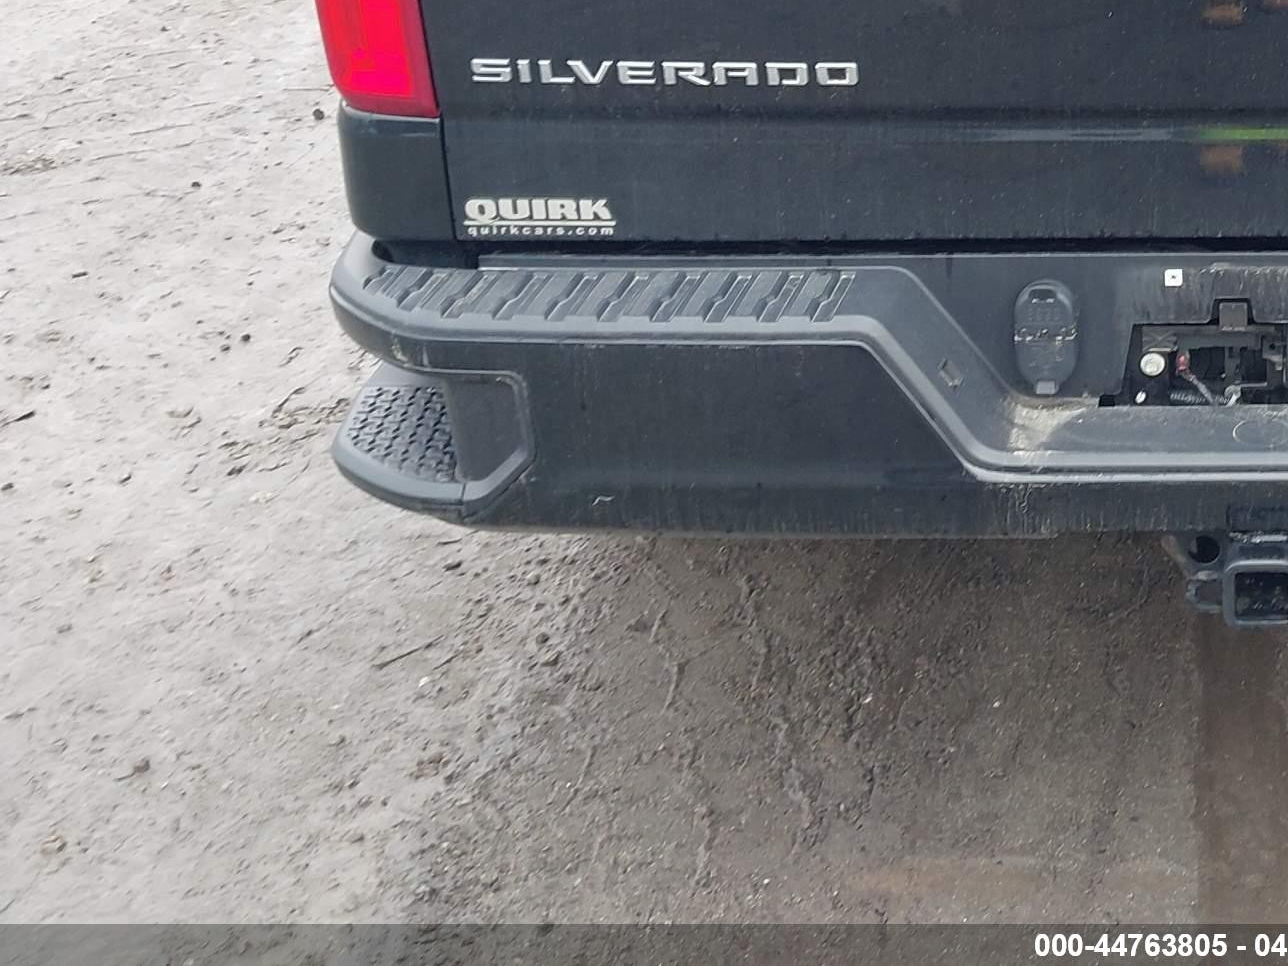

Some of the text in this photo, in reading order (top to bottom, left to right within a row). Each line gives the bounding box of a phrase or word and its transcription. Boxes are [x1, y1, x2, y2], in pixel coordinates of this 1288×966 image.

[470, 57, 860, 87] SILVERADO
[464, 197, 613, 222] QUIRK
[467, 225, 615, 238] quirkcars.com
